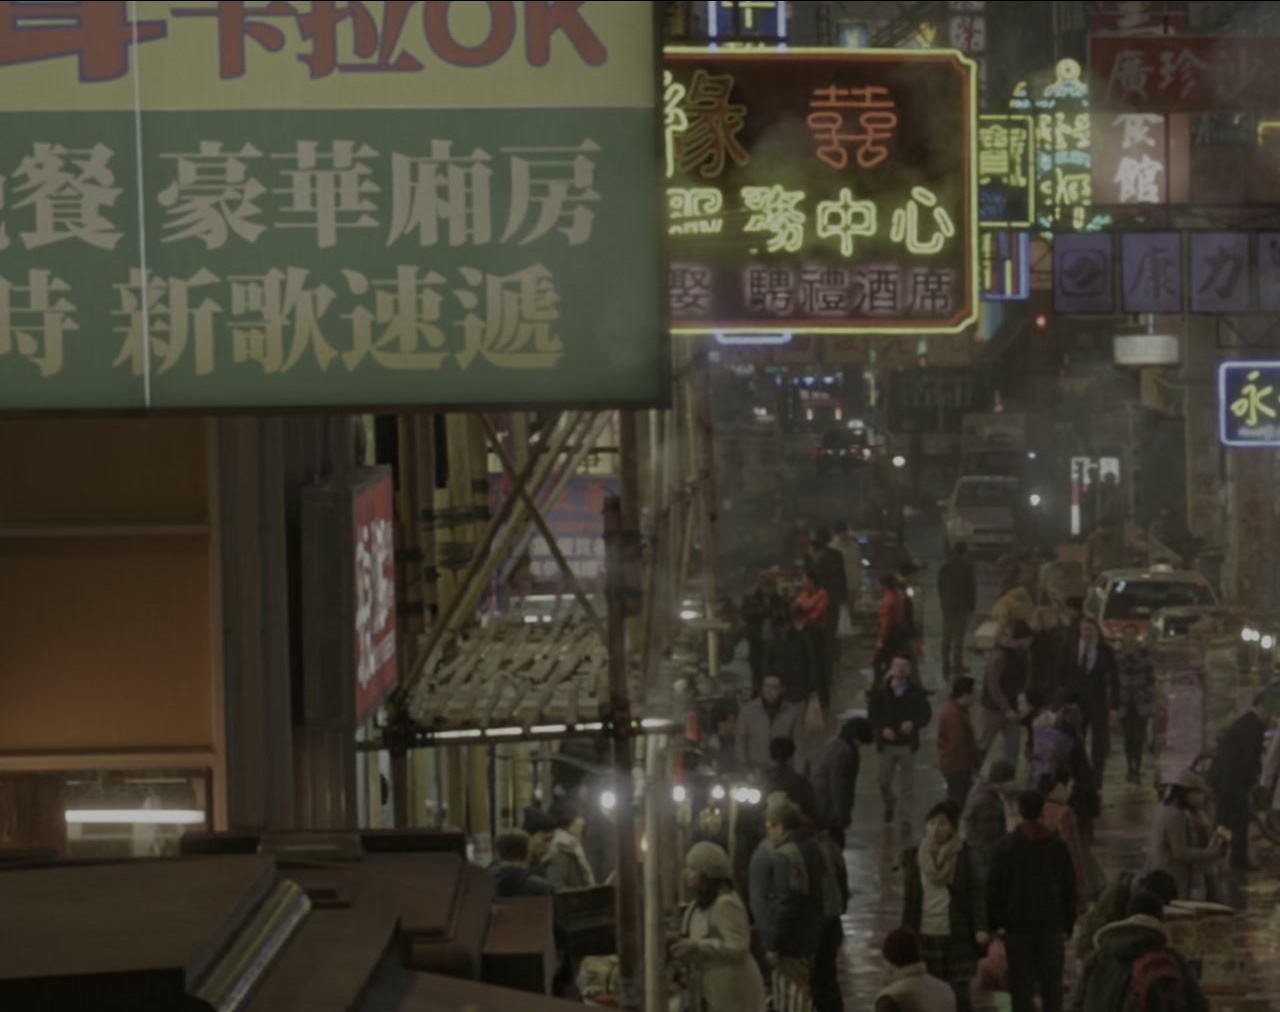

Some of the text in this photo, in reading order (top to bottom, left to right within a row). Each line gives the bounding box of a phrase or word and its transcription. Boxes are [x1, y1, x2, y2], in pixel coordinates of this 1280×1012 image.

[157, 136, 604, 250] 豪華廂房
[111, 262, 564, 376] 新歌速遞
